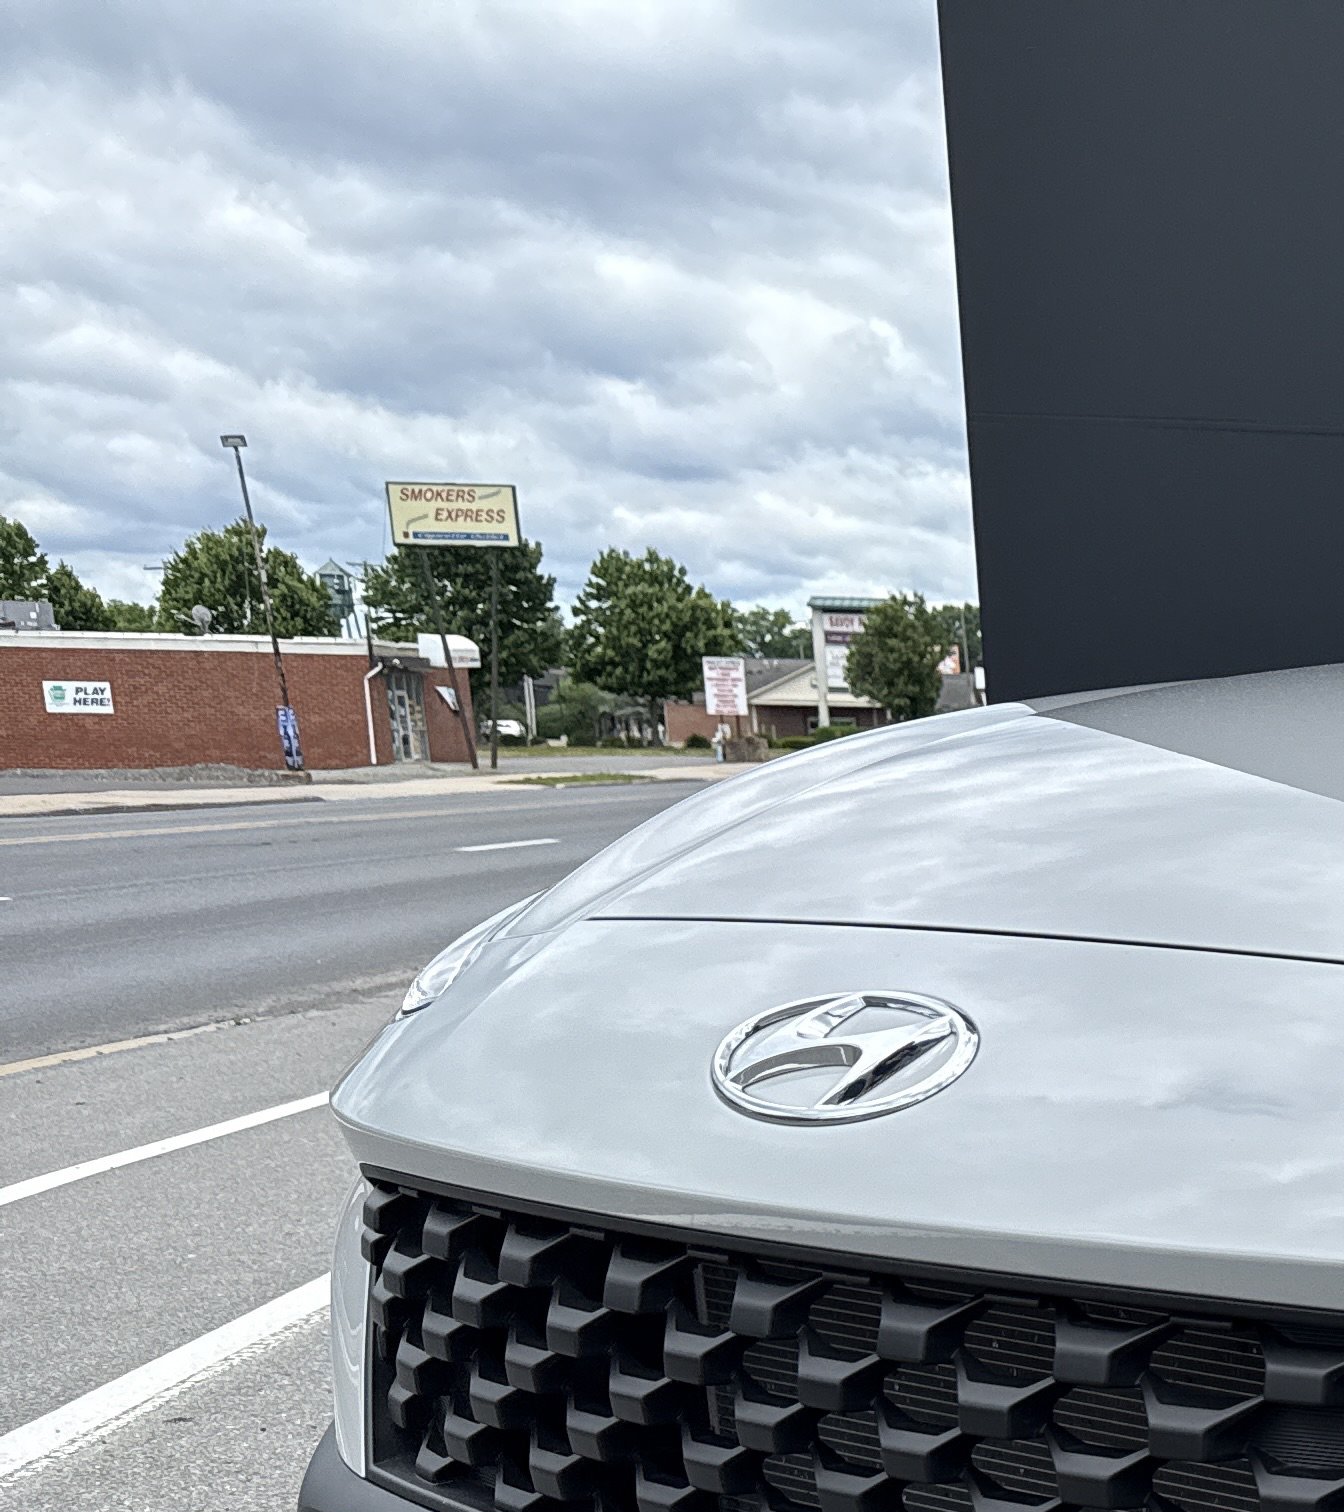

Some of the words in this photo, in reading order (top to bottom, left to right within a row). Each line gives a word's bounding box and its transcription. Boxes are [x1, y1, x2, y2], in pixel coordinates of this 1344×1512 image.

[400, 487, 476, 503] SMOKERS
[435, 508, 506, 524] EXPRESS
[75, 686, 106, 695] PLAY
